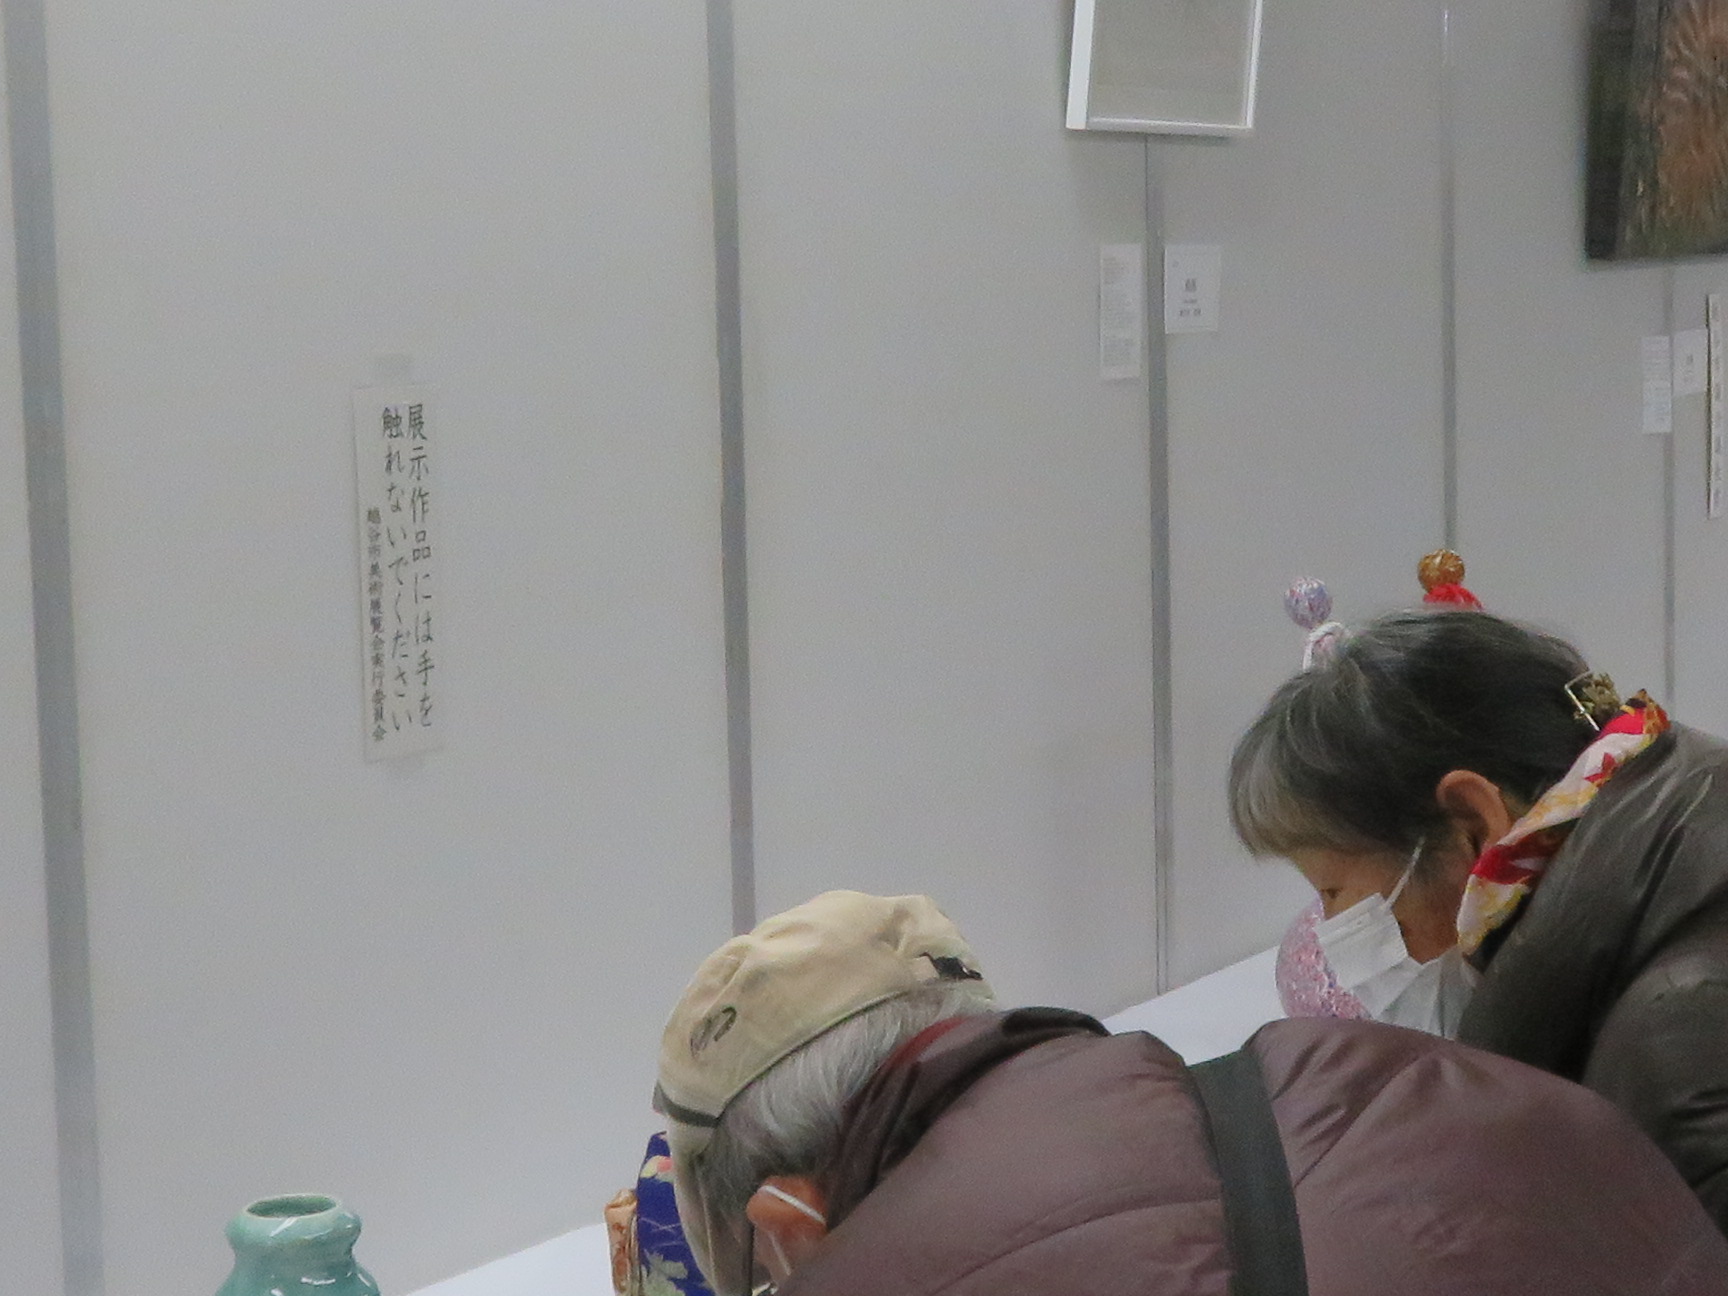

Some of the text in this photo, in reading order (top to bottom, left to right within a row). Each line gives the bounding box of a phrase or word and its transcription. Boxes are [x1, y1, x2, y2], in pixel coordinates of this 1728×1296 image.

[382, 406, 413, 732] 触れないでください
[408, 403, 436, 728] 展示作品には手を
